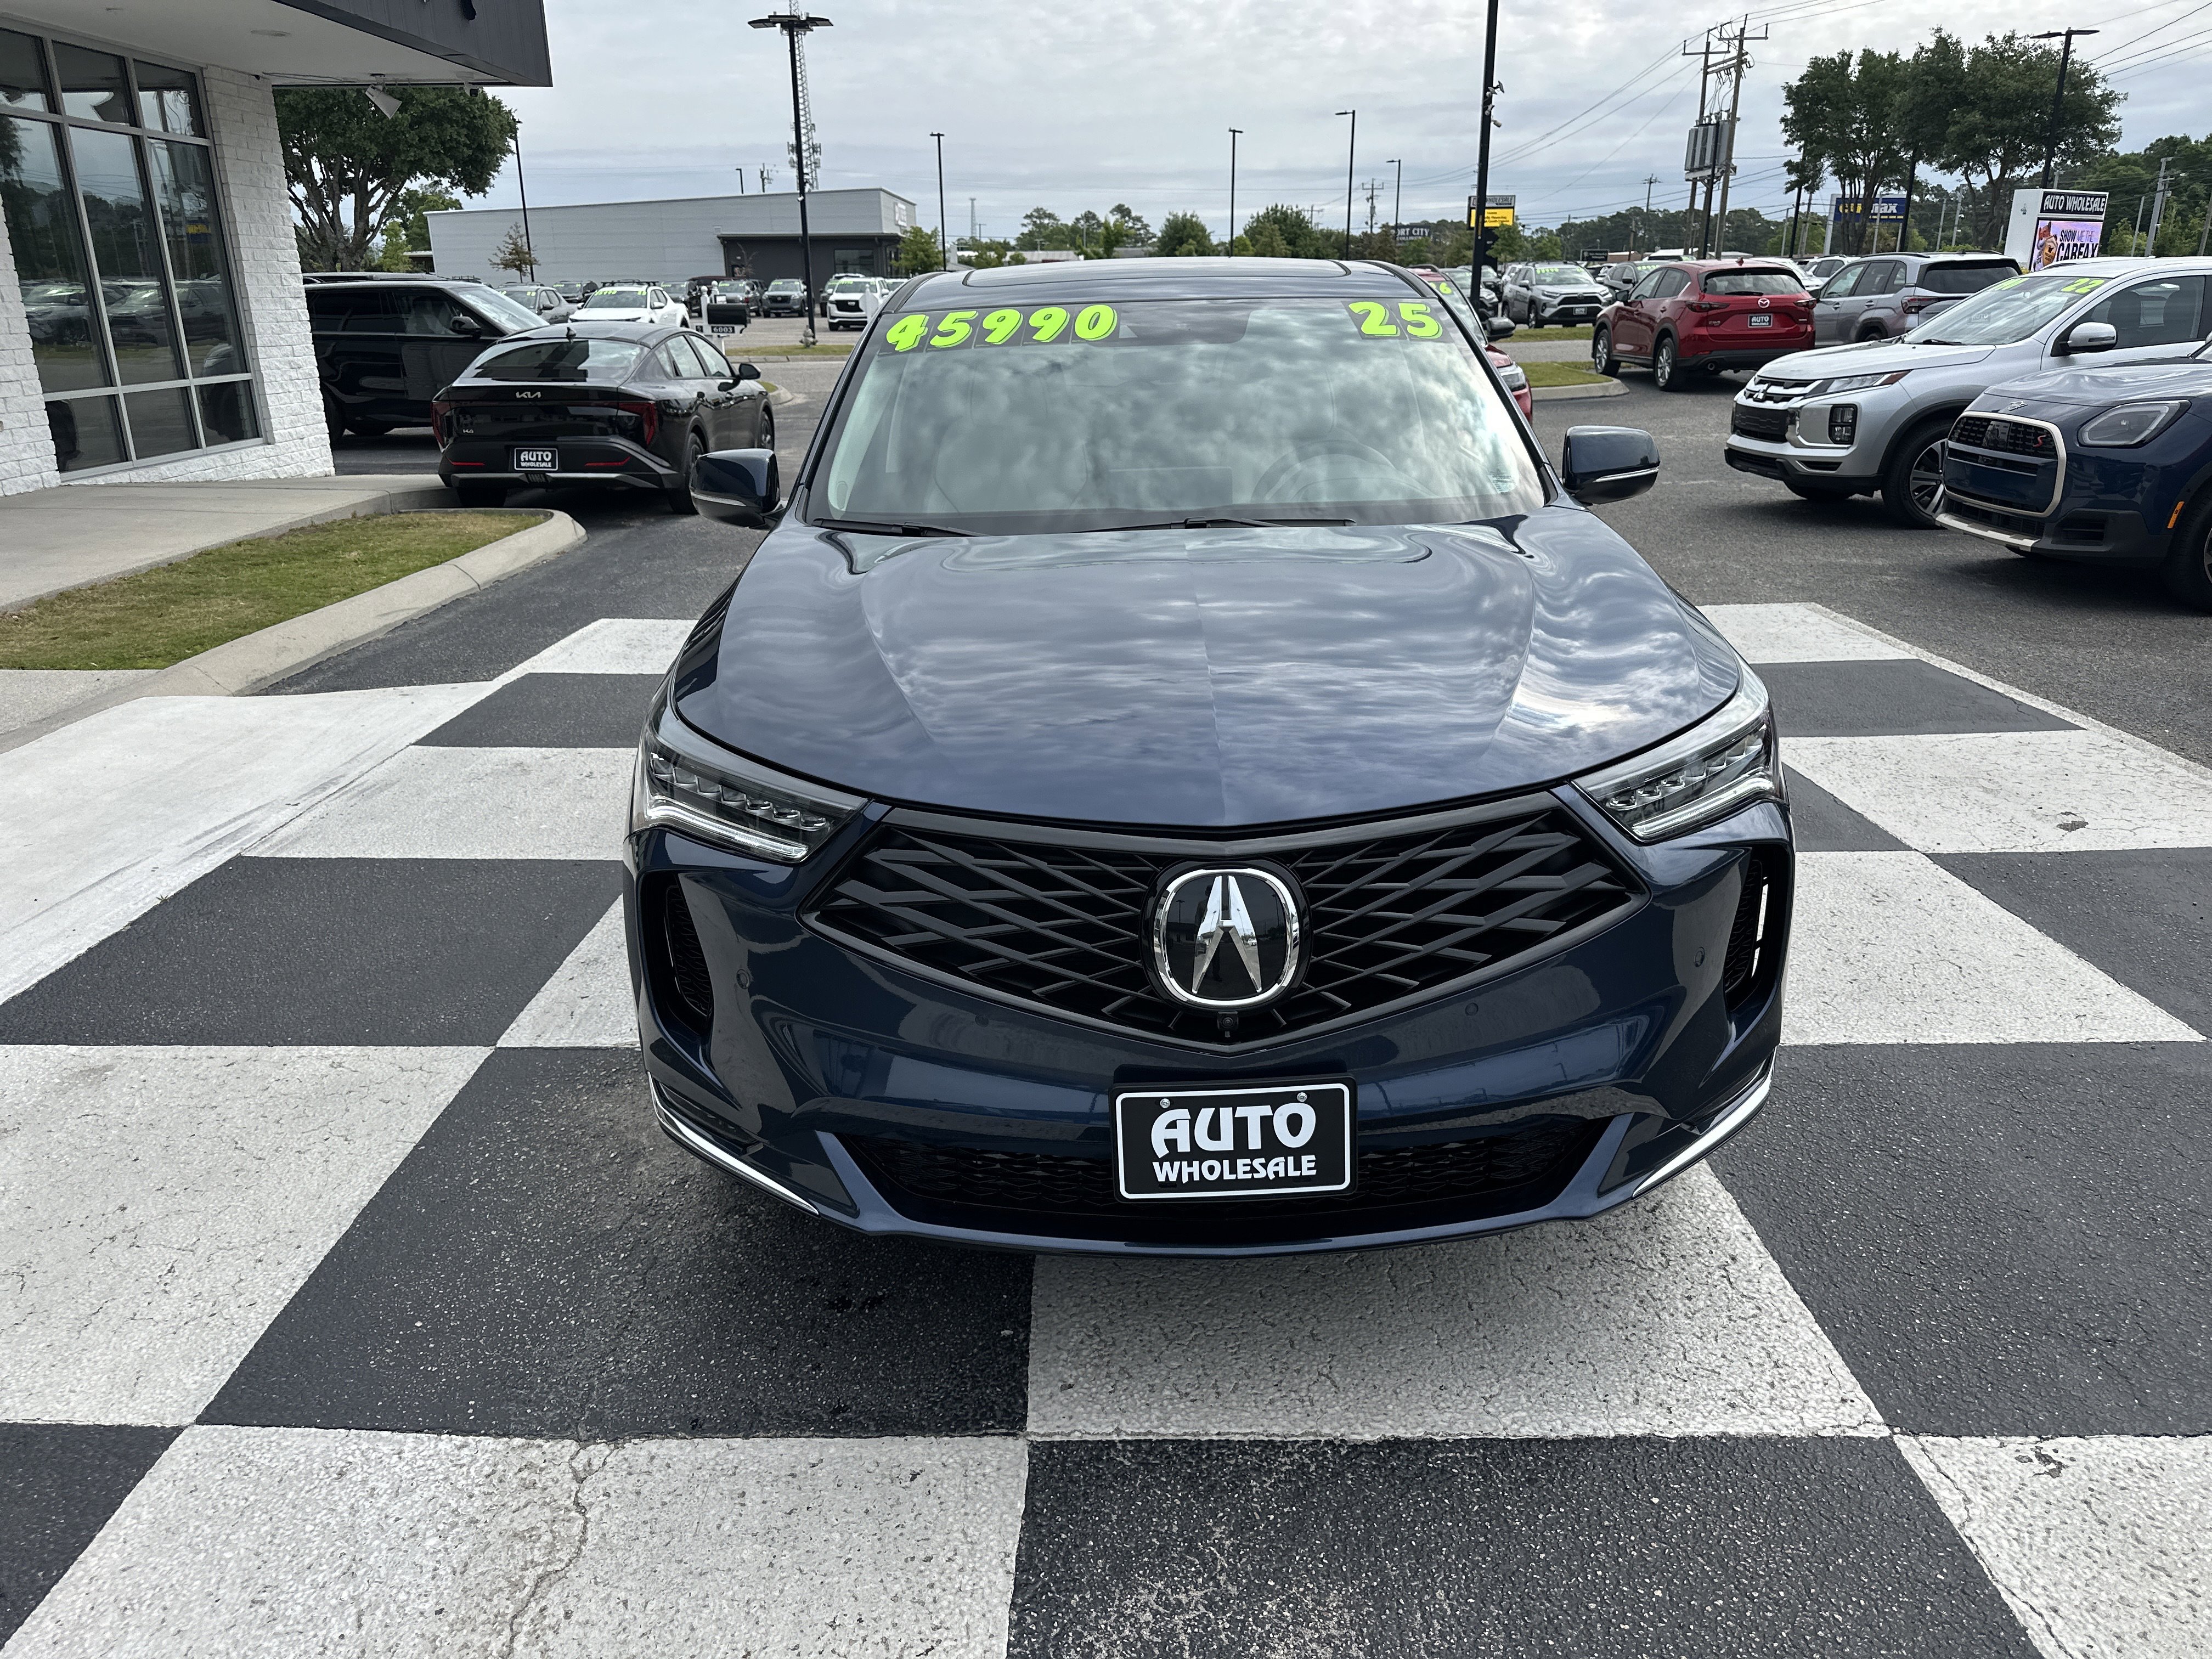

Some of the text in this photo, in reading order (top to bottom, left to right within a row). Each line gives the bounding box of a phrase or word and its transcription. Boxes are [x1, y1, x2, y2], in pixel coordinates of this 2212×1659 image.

[2043, 195, 2106, 212] AUTO WHOLESALE
[1412, 228, 1430, 236] CITY
[2059, 230, 2077, 242] SHOW
[2056, 242, 2098, 262] CARFAX
[2061, 278, 2106, 294] 22
[886, 301, 1443, 352] 45990 25
[520, 451, 552, 461] AUTO
[1151, 1102, 1316, 1159] AUTO
[1152, 1154, 1317, 1184] WHOLESALE
